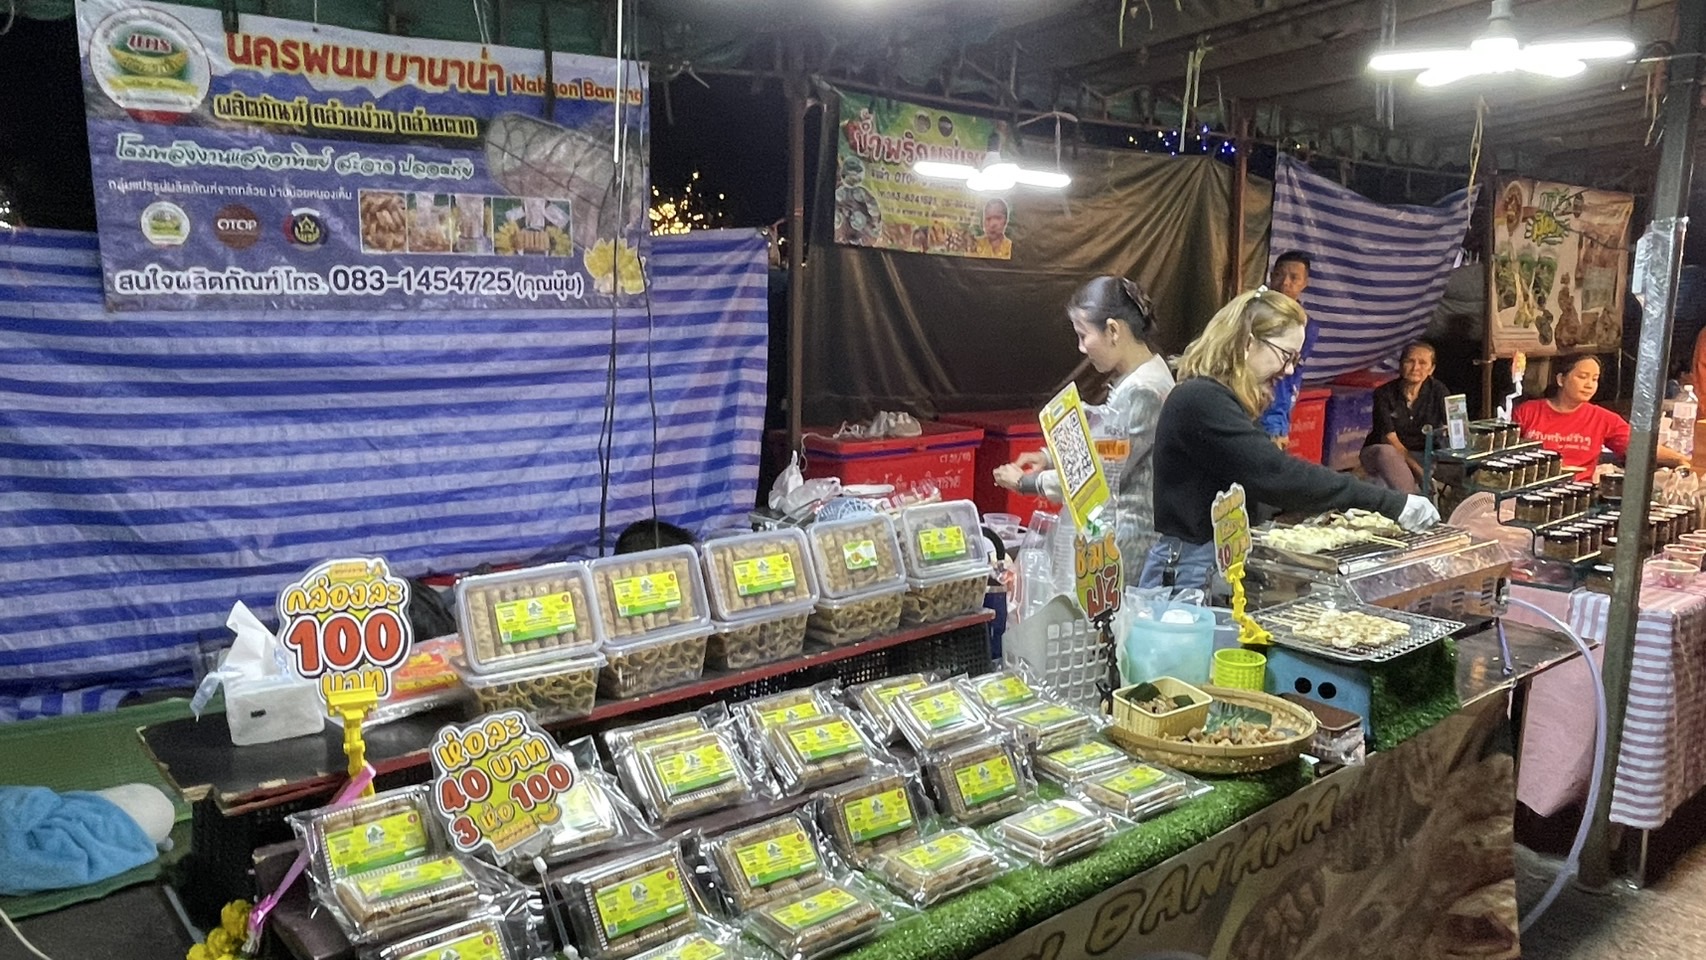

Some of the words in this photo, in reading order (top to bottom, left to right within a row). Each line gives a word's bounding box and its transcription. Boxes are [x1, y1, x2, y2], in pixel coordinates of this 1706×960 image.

[226, 32, 379, 80] นครพนม
[385, 46, 506, 93] บานาน่า
[216, 93, 307, 124] ผลิตภัณฑ์
[312, 101, 394, 131] กล้วยม้วน
[399, 109, 475, 136] กล้วยตาก
[335, 154, 395, 175] สะอาด
[399, 154, 474, 179] ปลอดภัย
[217, 218, 258, 231] OTOP
[118, 266, 279, 291] สนใจผลิตภัณฑ์
[331, 267, 512, 293] 083-1454725
[287, 577, 402, 612] กล่องละ
[289, 612, 401, 672] 100
[322, 670, 385, 696] บาท
[440, 718, 522, 769] ห่อละ
[441, 768, 489, 812] 40
[490, 738, 549, 779] บาท
[453, 815, 480, 845] 3
[480, 802, 514, 832] ห่อ
[511, 762, 571, 811] 100
[1084, 783, 1341, 956] BANANA
